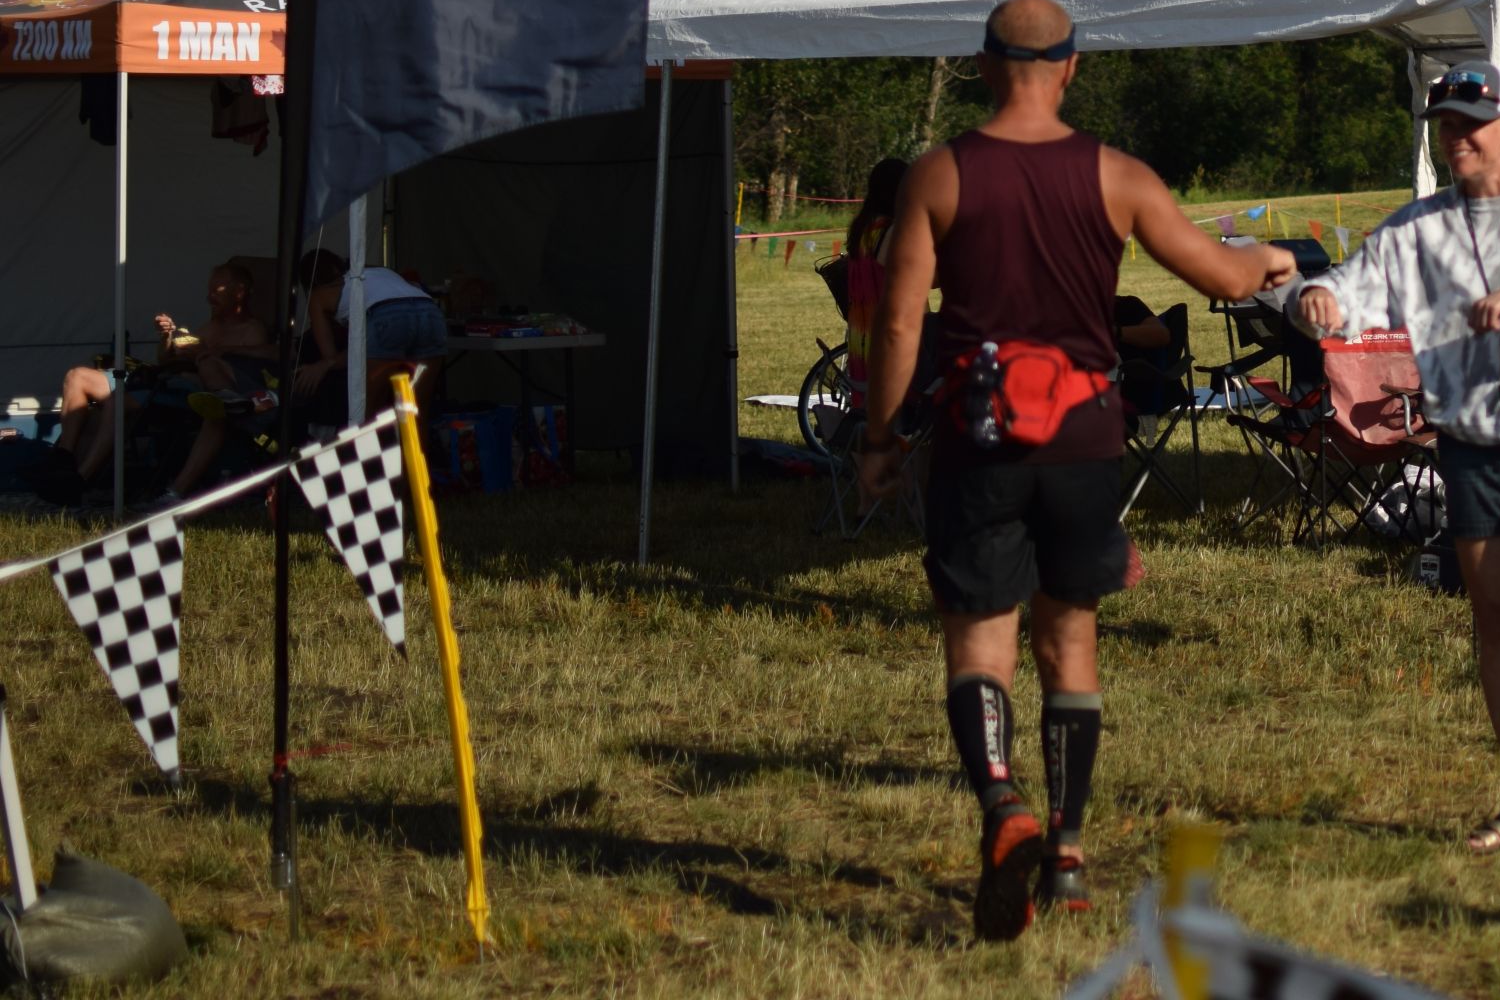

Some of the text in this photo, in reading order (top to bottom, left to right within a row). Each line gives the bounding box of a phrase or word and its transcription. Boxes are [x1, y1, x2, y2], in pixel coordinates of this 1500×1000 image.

[12, 20, 92, 61] 7200 KM
[153, 21, 261, 62] 1 MAN
